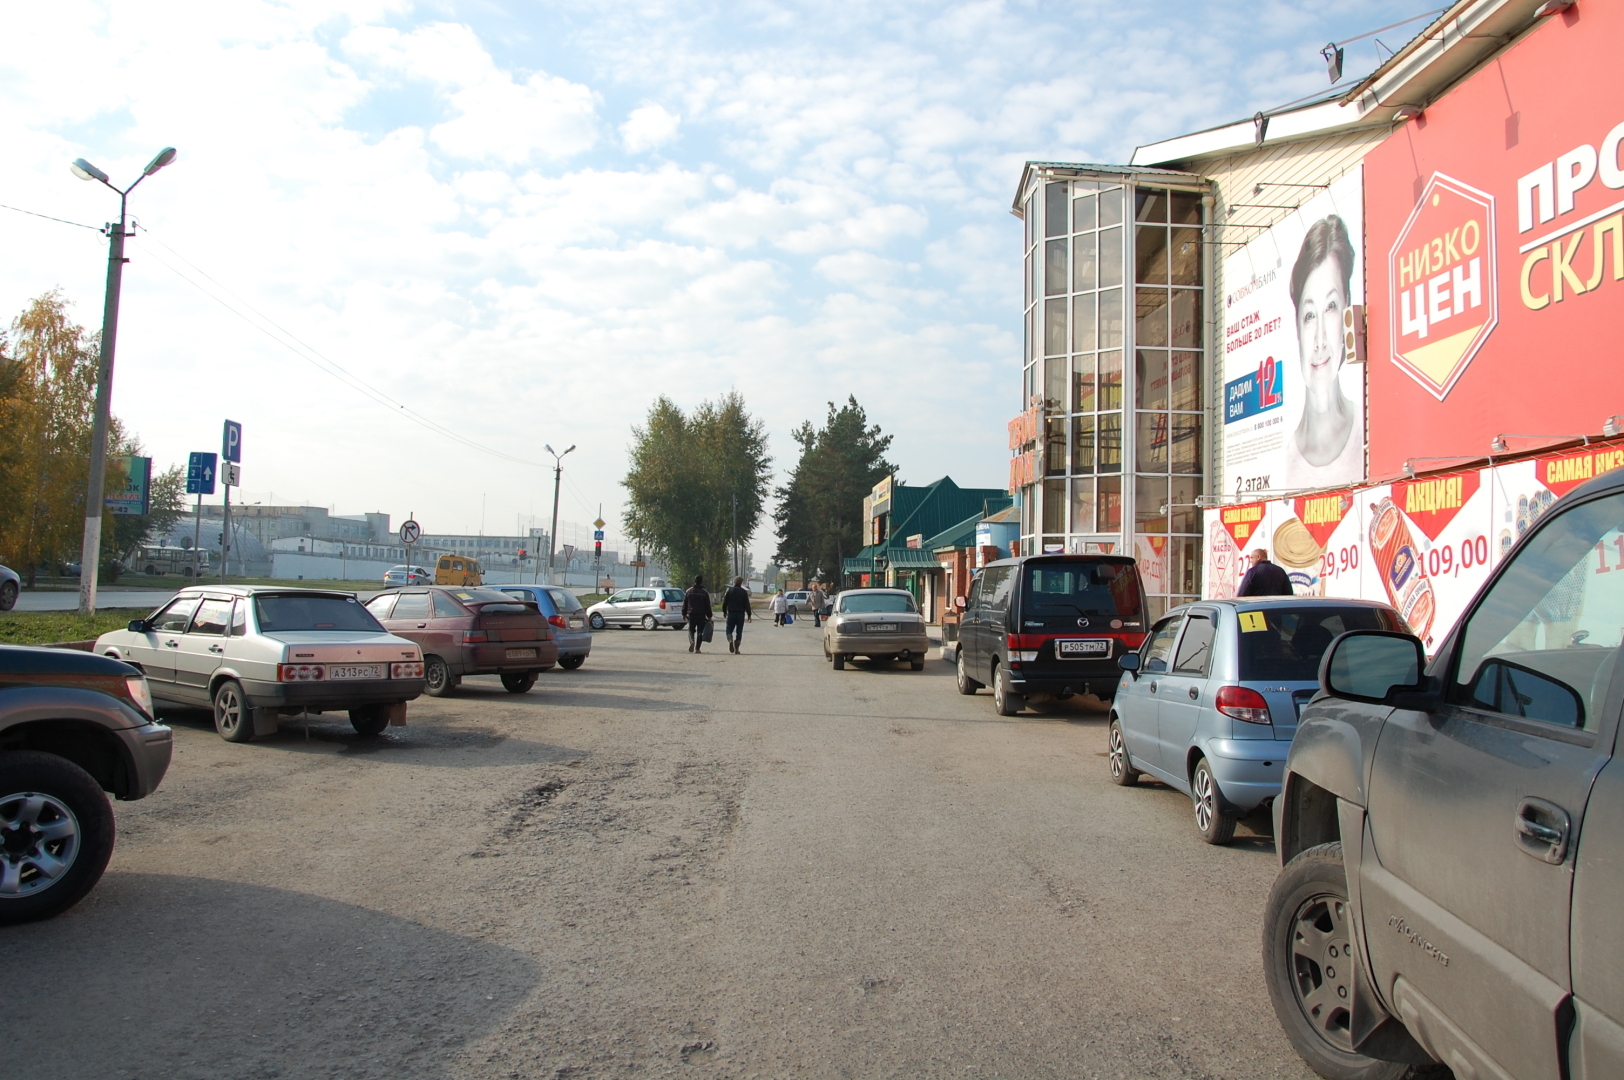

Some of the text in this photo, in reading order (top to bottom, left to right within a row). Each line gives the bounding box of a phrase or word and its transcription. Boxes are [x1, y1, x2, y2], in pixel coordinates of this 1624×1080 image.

[1400, 220, 1480, 289] НИЗКО
[1401, 257, 1482, 339] ЦЕН
[1226, 310, 1261, 338] ВАШ СТАЖ
[1226, 317, 1282, 353] БОЛЬШЕ 20 ЛЕТ?
[1229, 379, 1252, 402] ДАДИМ
[1008, 395, 1038, 449] ТВОЙ
[1229, 401, 1244, 418] ВАМ
[227, 425, 239, 457] P
[1236, 475, 1270, 493] 2 этаж
[1546, 455, 1592, 484] САМАЯ
[1303, 495, 1342, 526] АКЦИЯ!
[1405, 476, 1463, 515] АКЦИЯ!
[1213, 544, 1231, 552] МАСЛО
[1319, 544, 1359, 579] 29,90
[1417, 535, 1488, 578] 109,00
[370, 666, 379, 674] 72
[1387, 915, 1450, 967] AVALANCHE
